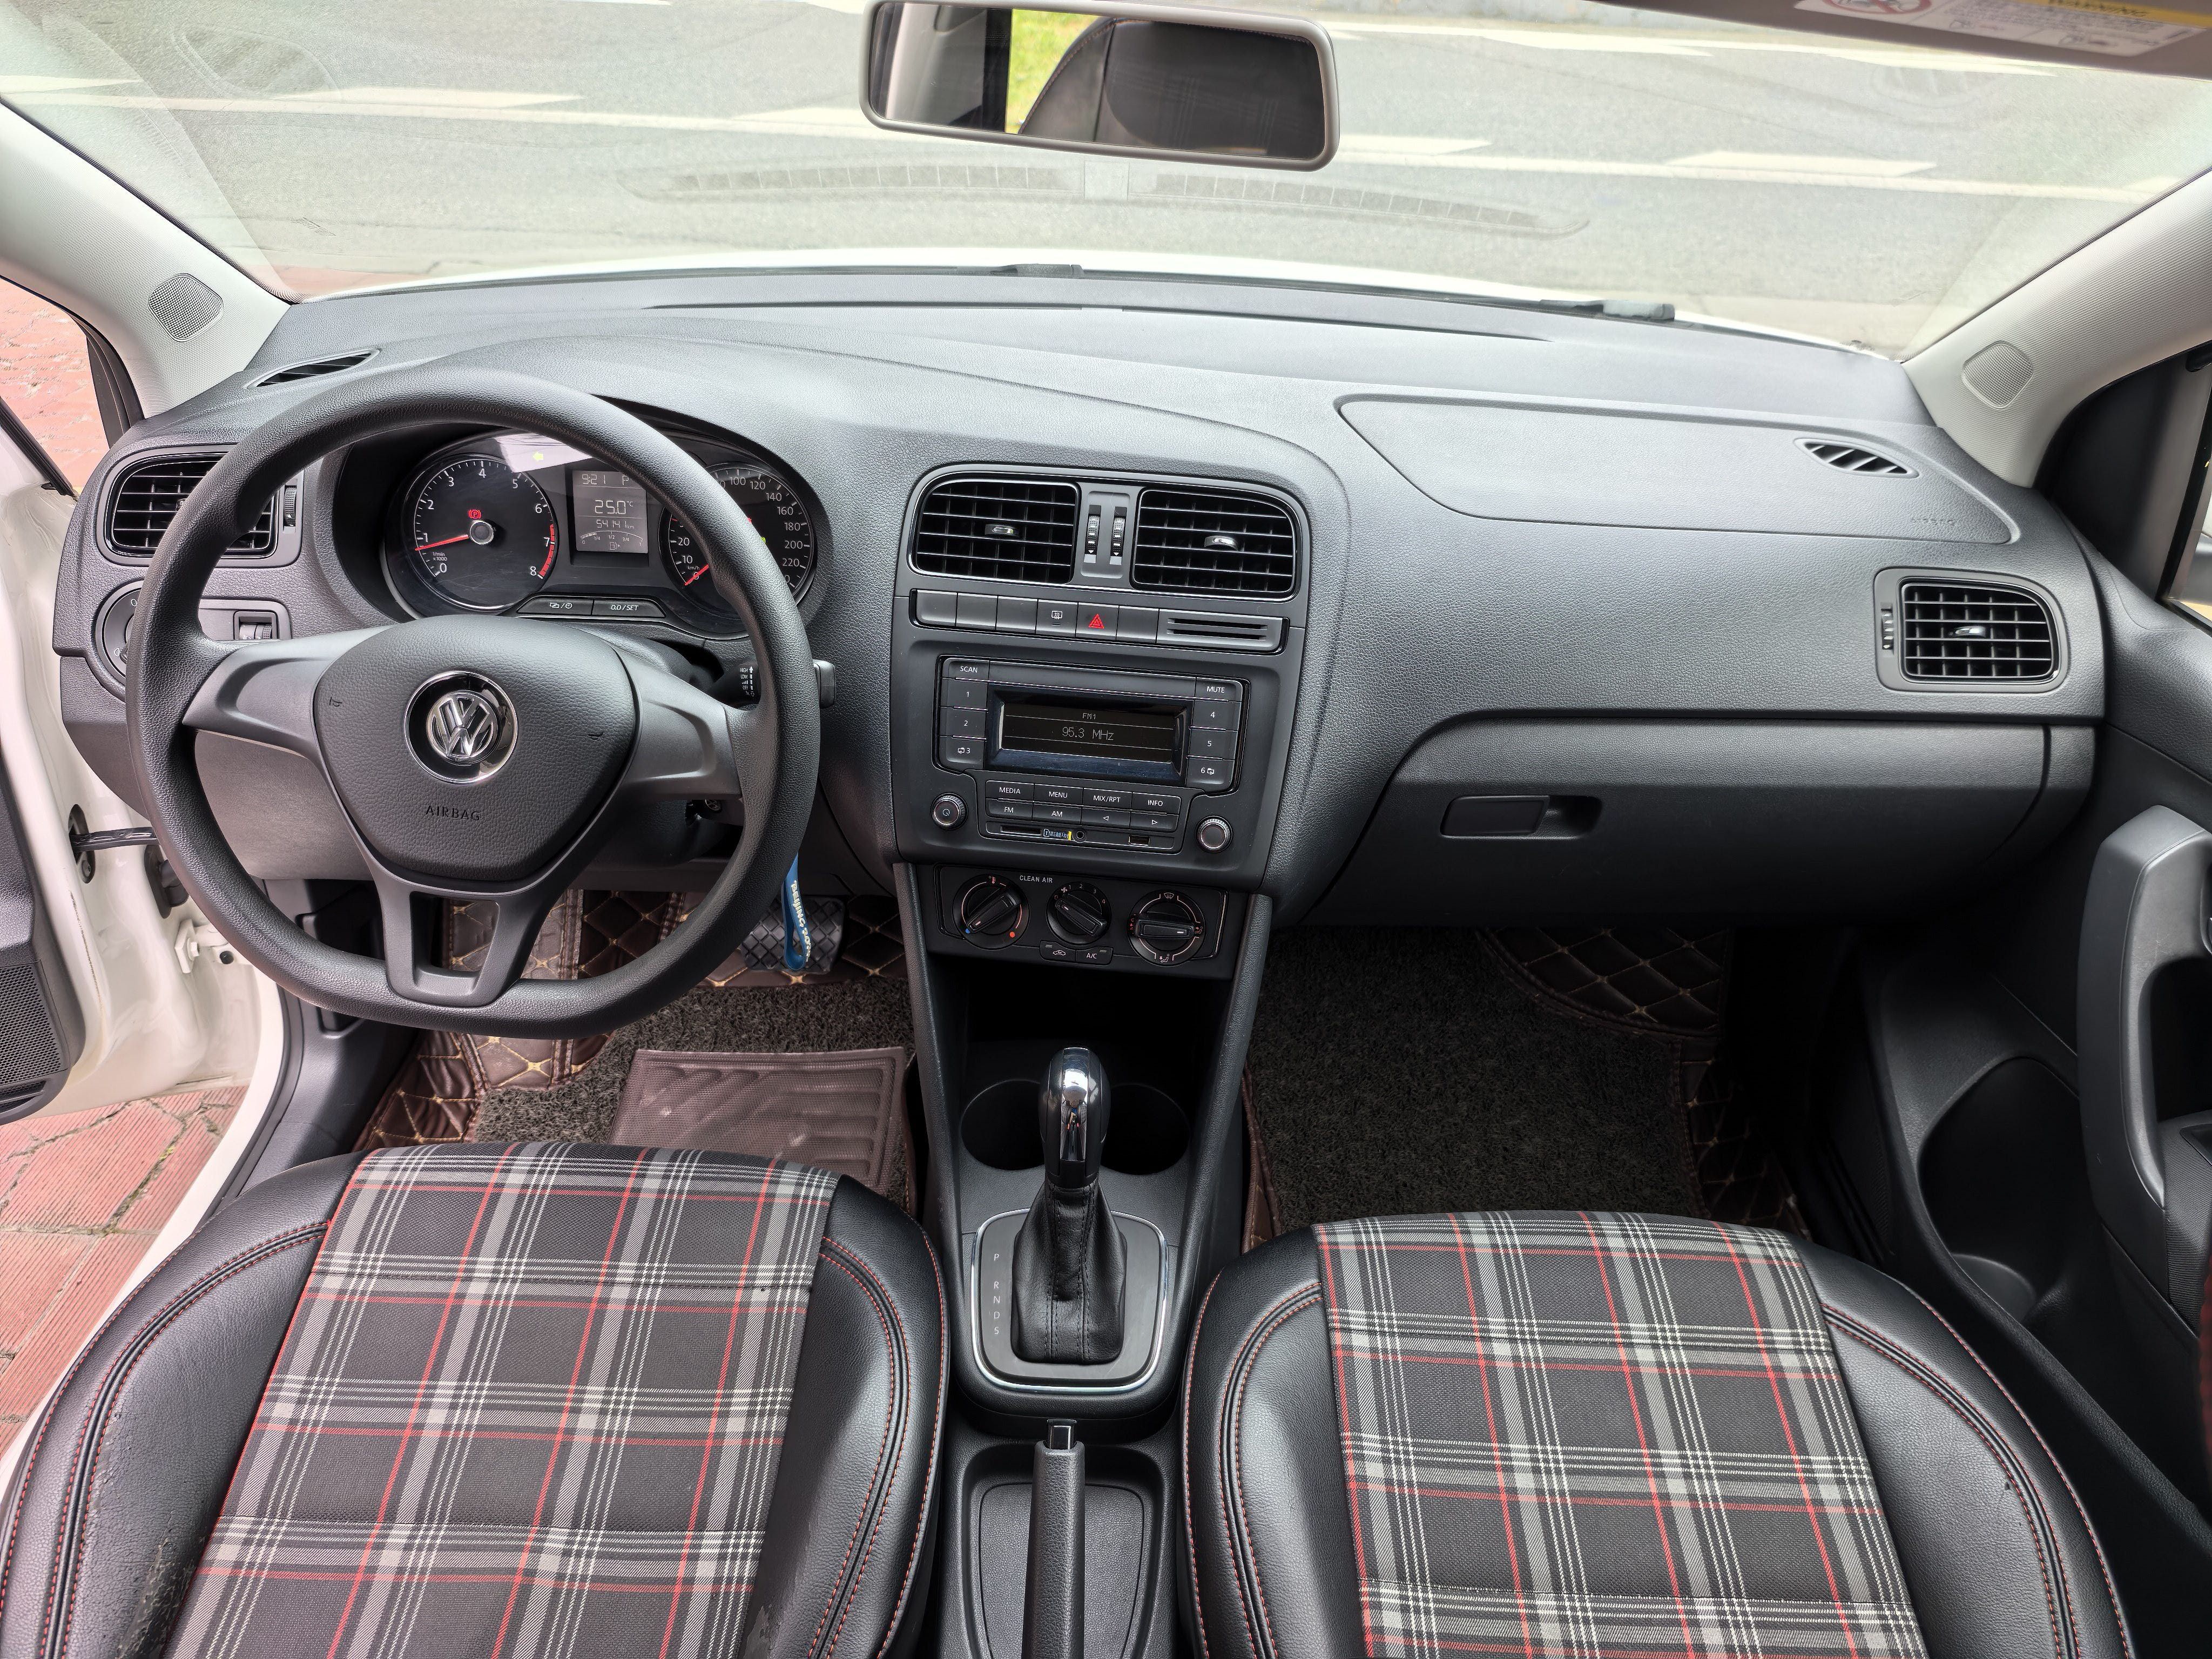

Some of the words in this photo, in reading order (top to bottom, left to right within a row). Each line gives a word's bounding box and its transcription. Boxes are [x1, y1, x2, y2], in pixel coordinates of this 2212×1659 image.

[479, 468, 486, 478] 4
[449, 477, 454, 487] 3
[513, 480, 518, 488] 5
[582, 474, 606, 484] 9:21
[623, 475, 629, 485] P
[729, 477, 746, 485] 100
[750, 481, 766, 490] 120
[766, 493, 782, 501] 140
[428, 500, 434, 510] 2
[535, 504, 542, 513] 6
[777, 507, 793, 515] 160
[784, 522, 800, 531] 180
[423, 533, 428, 542] 1
[543, 537, 550, 547] 7
[678, 537, 690, 546] 20
[785, 540, 803, 549] 200
[682, 555, 693, 564] 10
[783, 558, 800, 567] 220
[440, 563, 447, 573] 0
[530, 567, 537, 576] 8
[1062, 726, 1085, 738] 95.3
[1092, 729, 1114, 740] MHz
[999, 786, 1021, 794] MEDIA
[1093, 795, 1121, 804] MIX/RPT
[426, 805, 480, 821] AIRBAG
[791, 880, 806, 927] BEIJING
[994, 1281, 1000, 1289] R
[994, 1326, 1000, 1334] S
